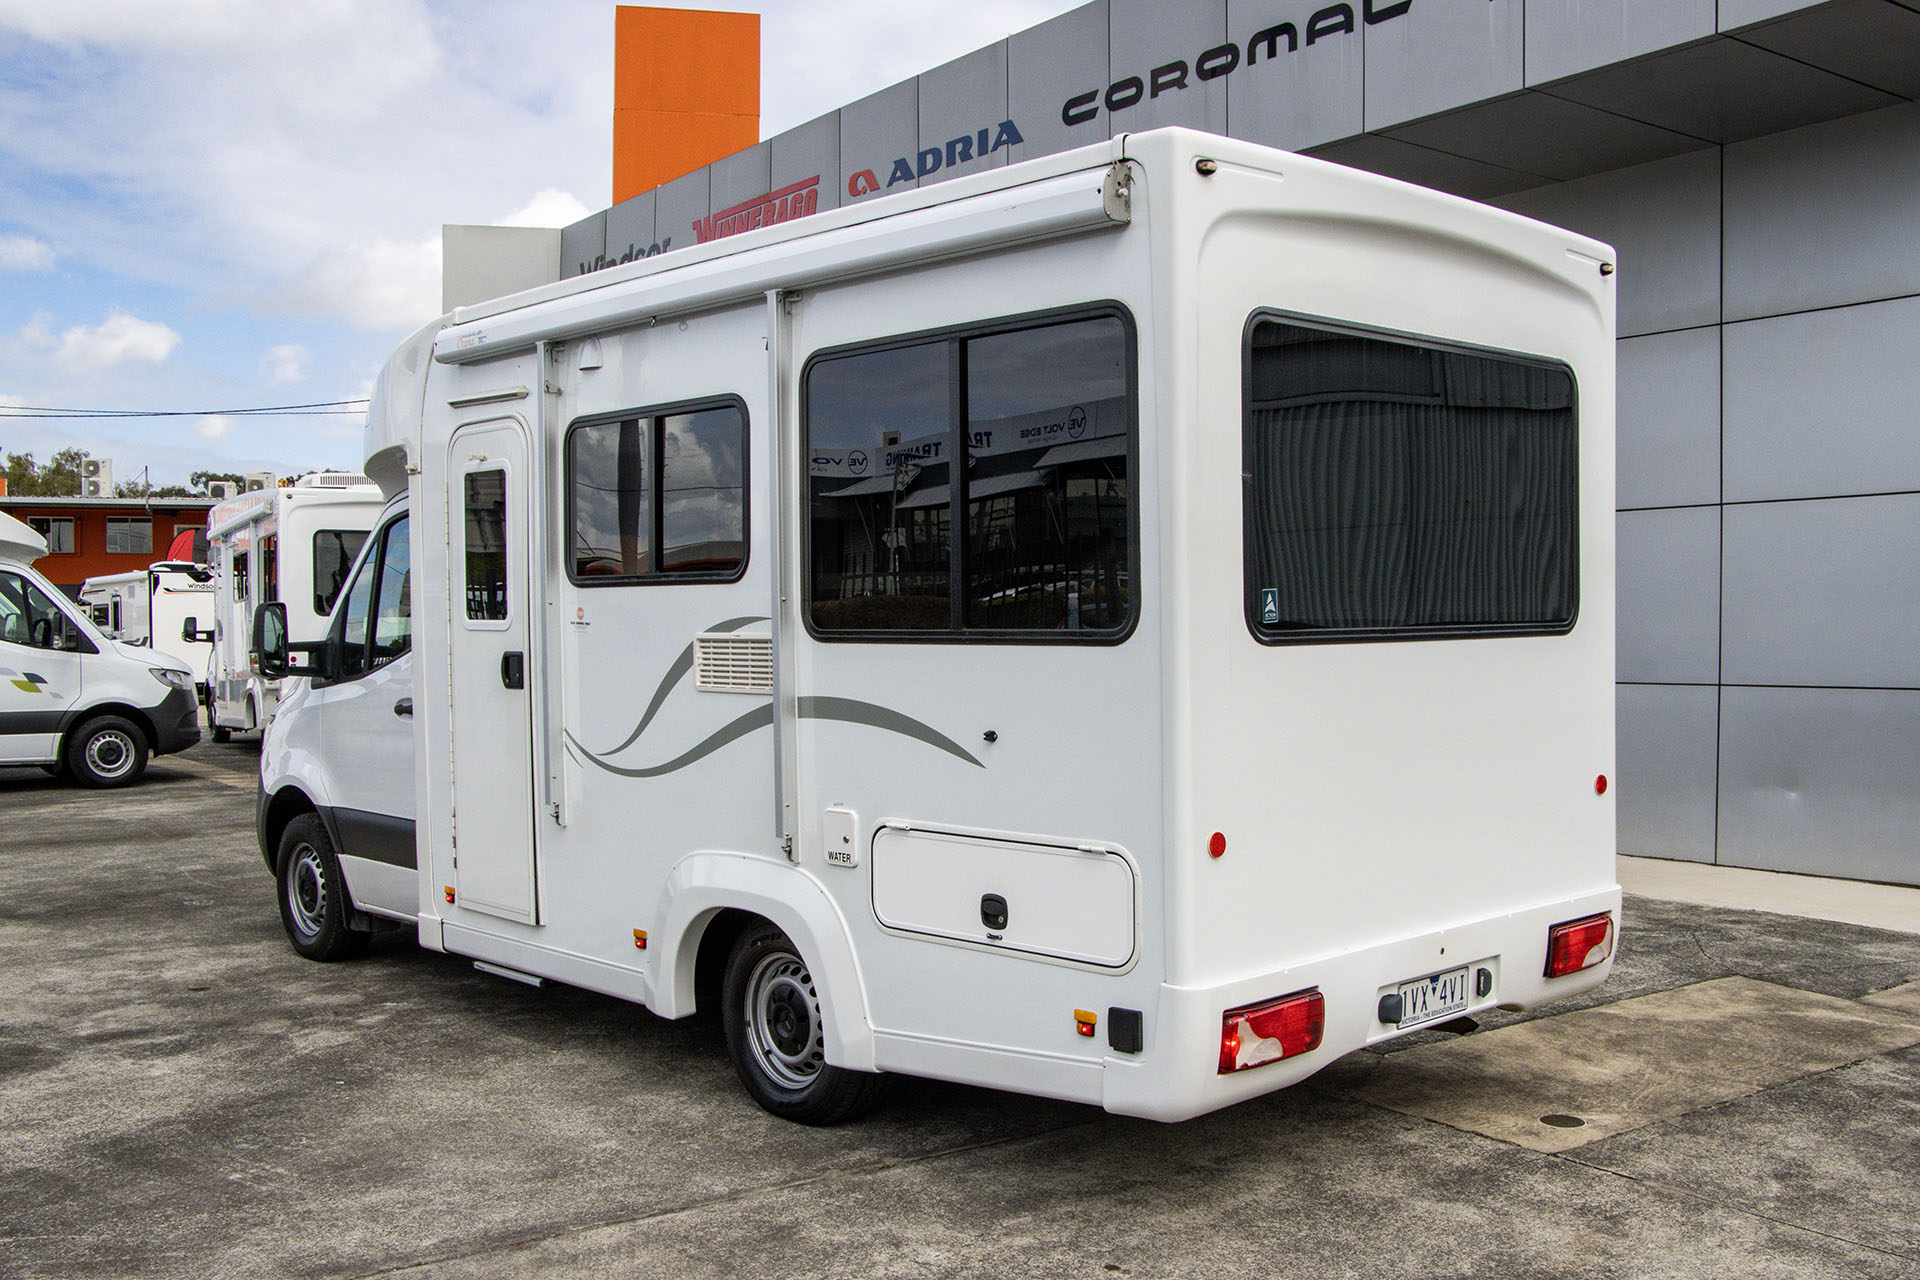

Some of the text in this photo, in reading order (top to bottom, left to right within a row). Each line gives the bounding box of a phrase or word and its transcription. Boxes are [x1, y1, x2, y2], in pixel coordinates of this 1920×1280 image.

[1061, 0, 1412, 126] COROMAL
[886, 119, 1024, 188] ADRIA
[691, 173, 820, 244] WINNEBAGO
[828, 851, 852, 862] WATER
